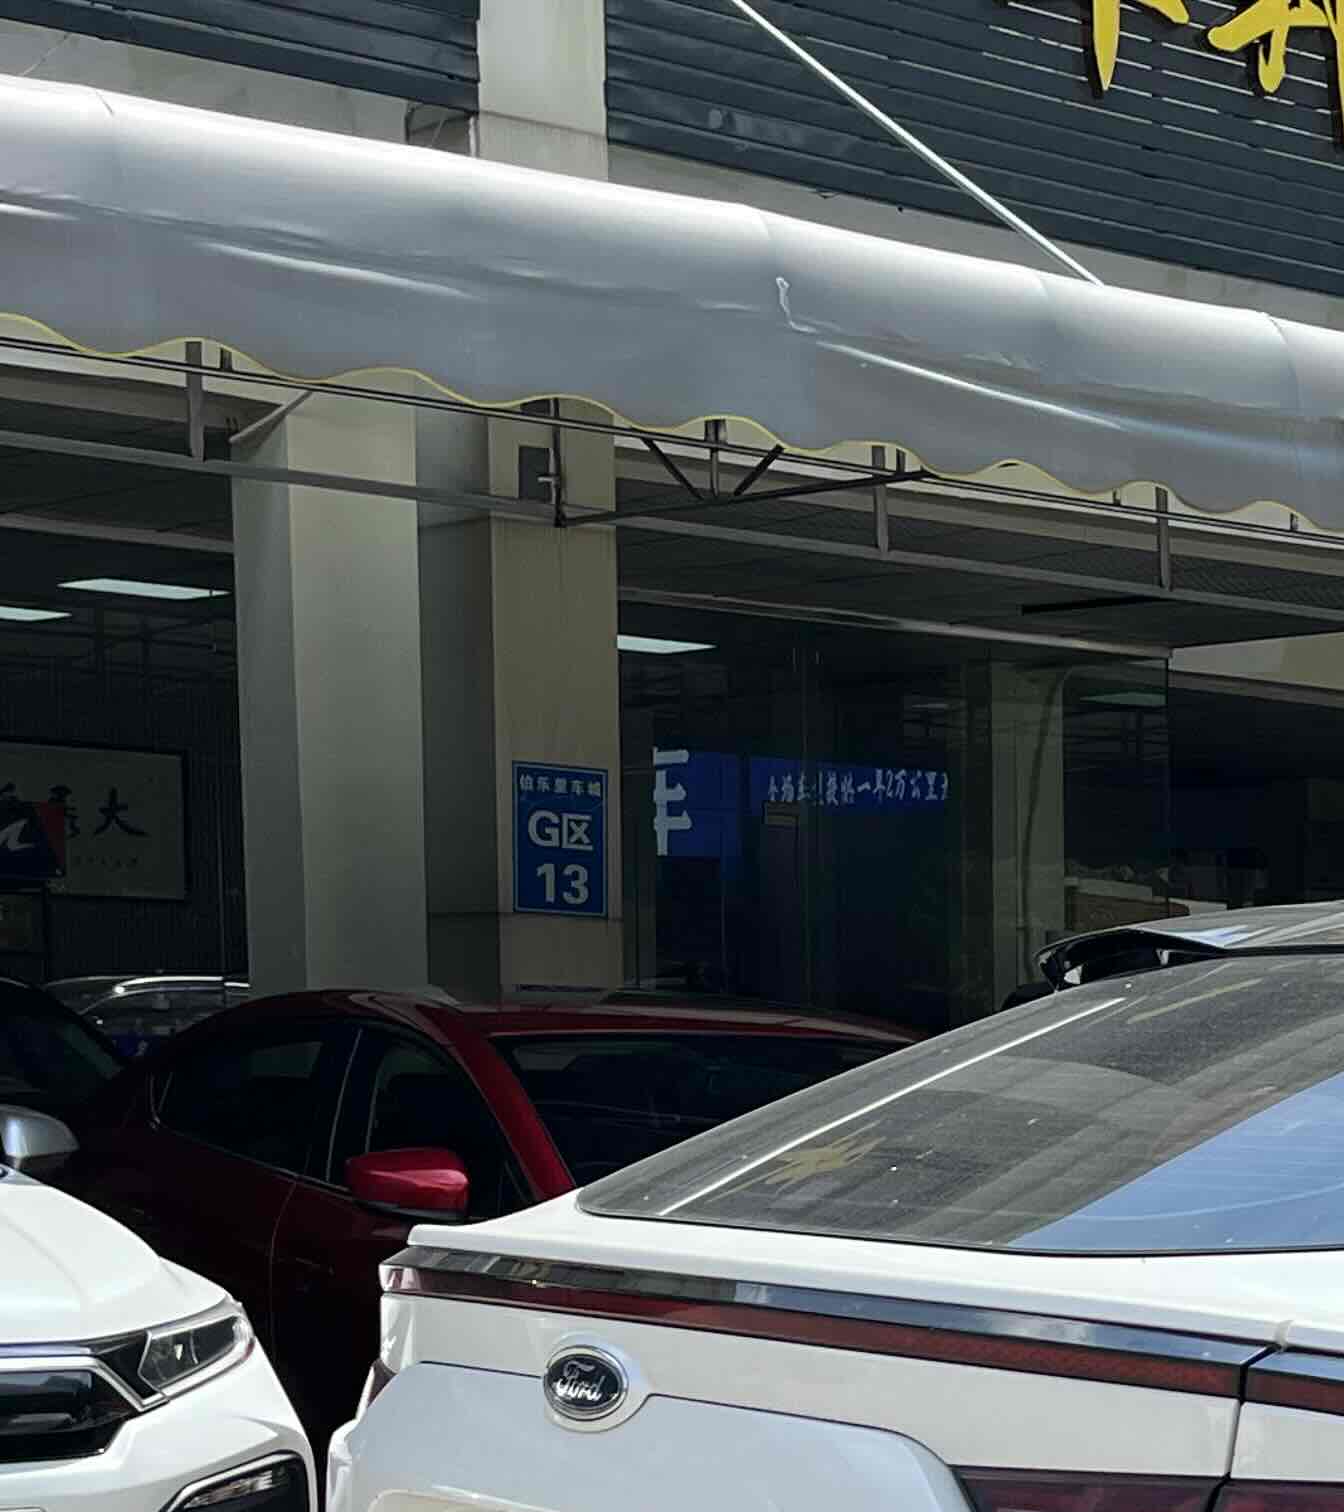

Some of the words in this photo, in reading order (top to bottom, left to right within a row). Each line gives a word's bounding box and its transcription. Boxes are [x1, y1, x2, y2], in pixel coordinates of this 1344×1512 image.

[528, 809, 594, 851] G区
[536, 863, 590, 905] 13
[553, 1360, 606, 1402] Ford
